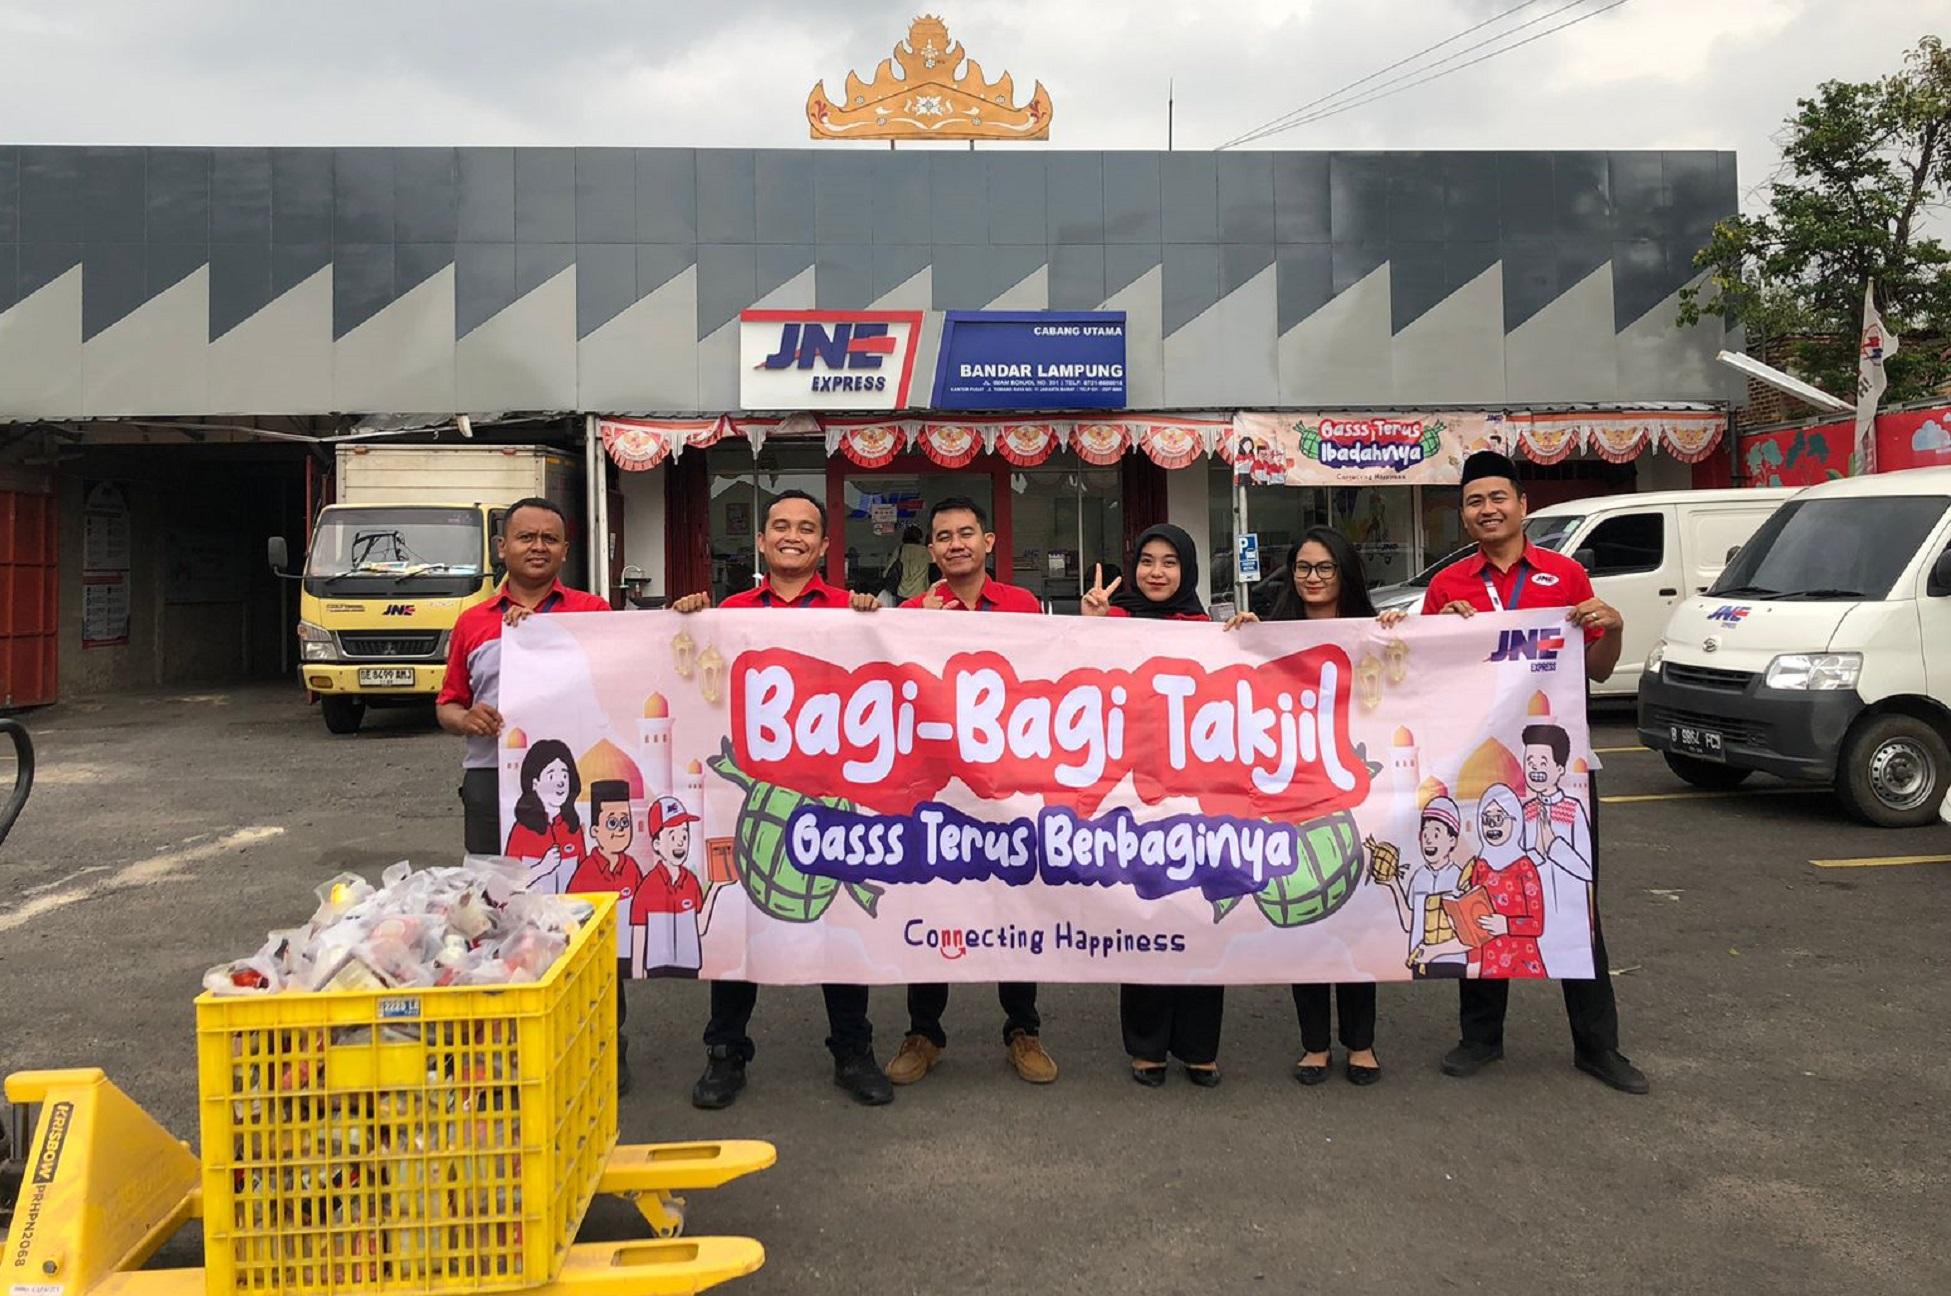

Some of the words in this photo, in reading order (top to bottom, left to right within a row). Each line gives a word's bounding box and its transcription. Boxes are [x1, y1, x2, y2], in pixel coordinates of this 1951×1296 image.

[1034, 327, 1080, 336] CABANG
[1083, 327, 1122, 336] UTAMA
[753, 323, 897, 370] JNE
[811, 376, 887, 392] EXPRESS
[960, 364, 1031, 378] BANDAR
[1038, 364, 1123, 378] LAMPUNG
[1321, 421, 1370, 438] Gasss
[1374, 421, 1420, 438] Terus
[1321, 442, 1421, 465] Ibadahnya
[382, 604, 416, 616] JNE
[1707, 605, 1752, 621] JNE
[1484, 628, 1565, 662] JNE
[745, 665, 1128, 789] Bagi-Bagi
[1152, 660, 1356, 794] Takjil
[792, 816, 904, 865] Gasss
[919, 809, 1029, 866] Terus
[1045, 813, 1292, 882] Berbaginya
[904, 919, 1044, 956] Connecting
[1055, 922, 1186, 955] Happiness
[39, 1104, 70, 1180] KRISBOW
[15, 1184, 46, 1267] PRHPN2068
